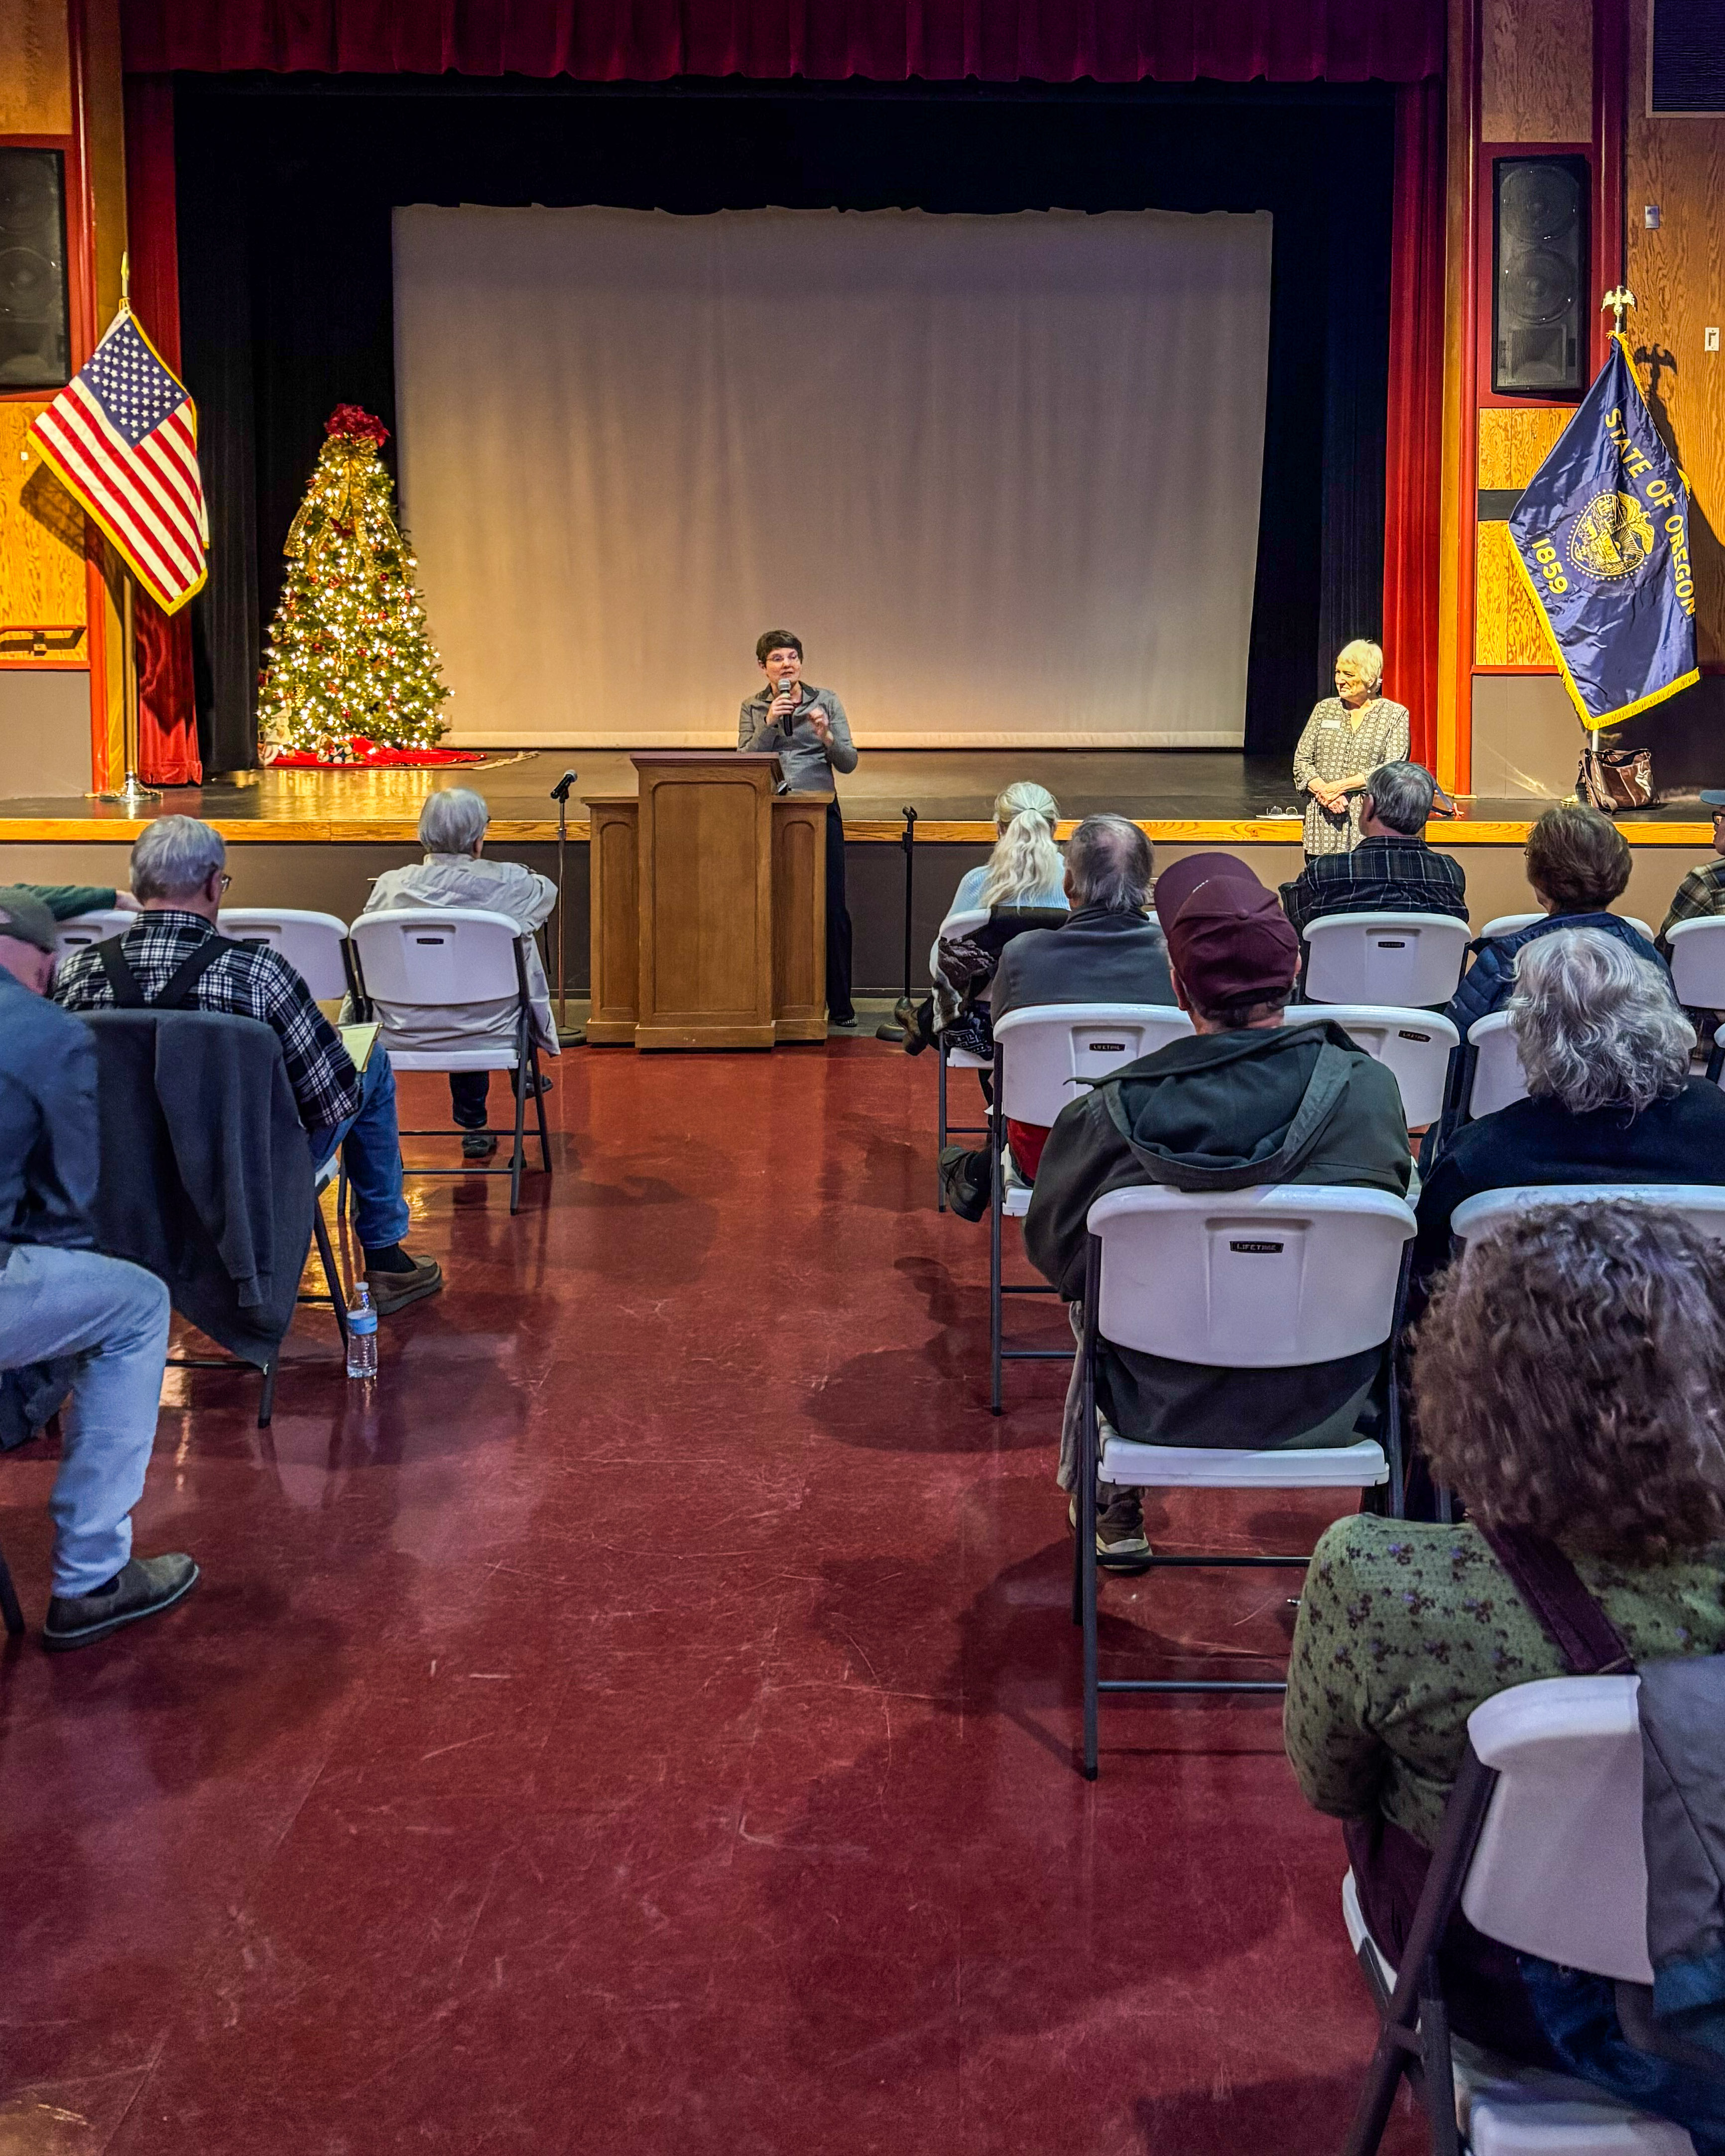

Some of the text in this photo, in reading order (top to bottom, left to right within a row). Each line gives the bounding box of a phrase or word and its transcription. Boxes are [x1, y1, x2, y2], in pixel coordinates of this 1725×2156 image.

[1531, 538, 1568, 594] 1859
[1605, 408, 1696, 616] STATE OF OREGON
